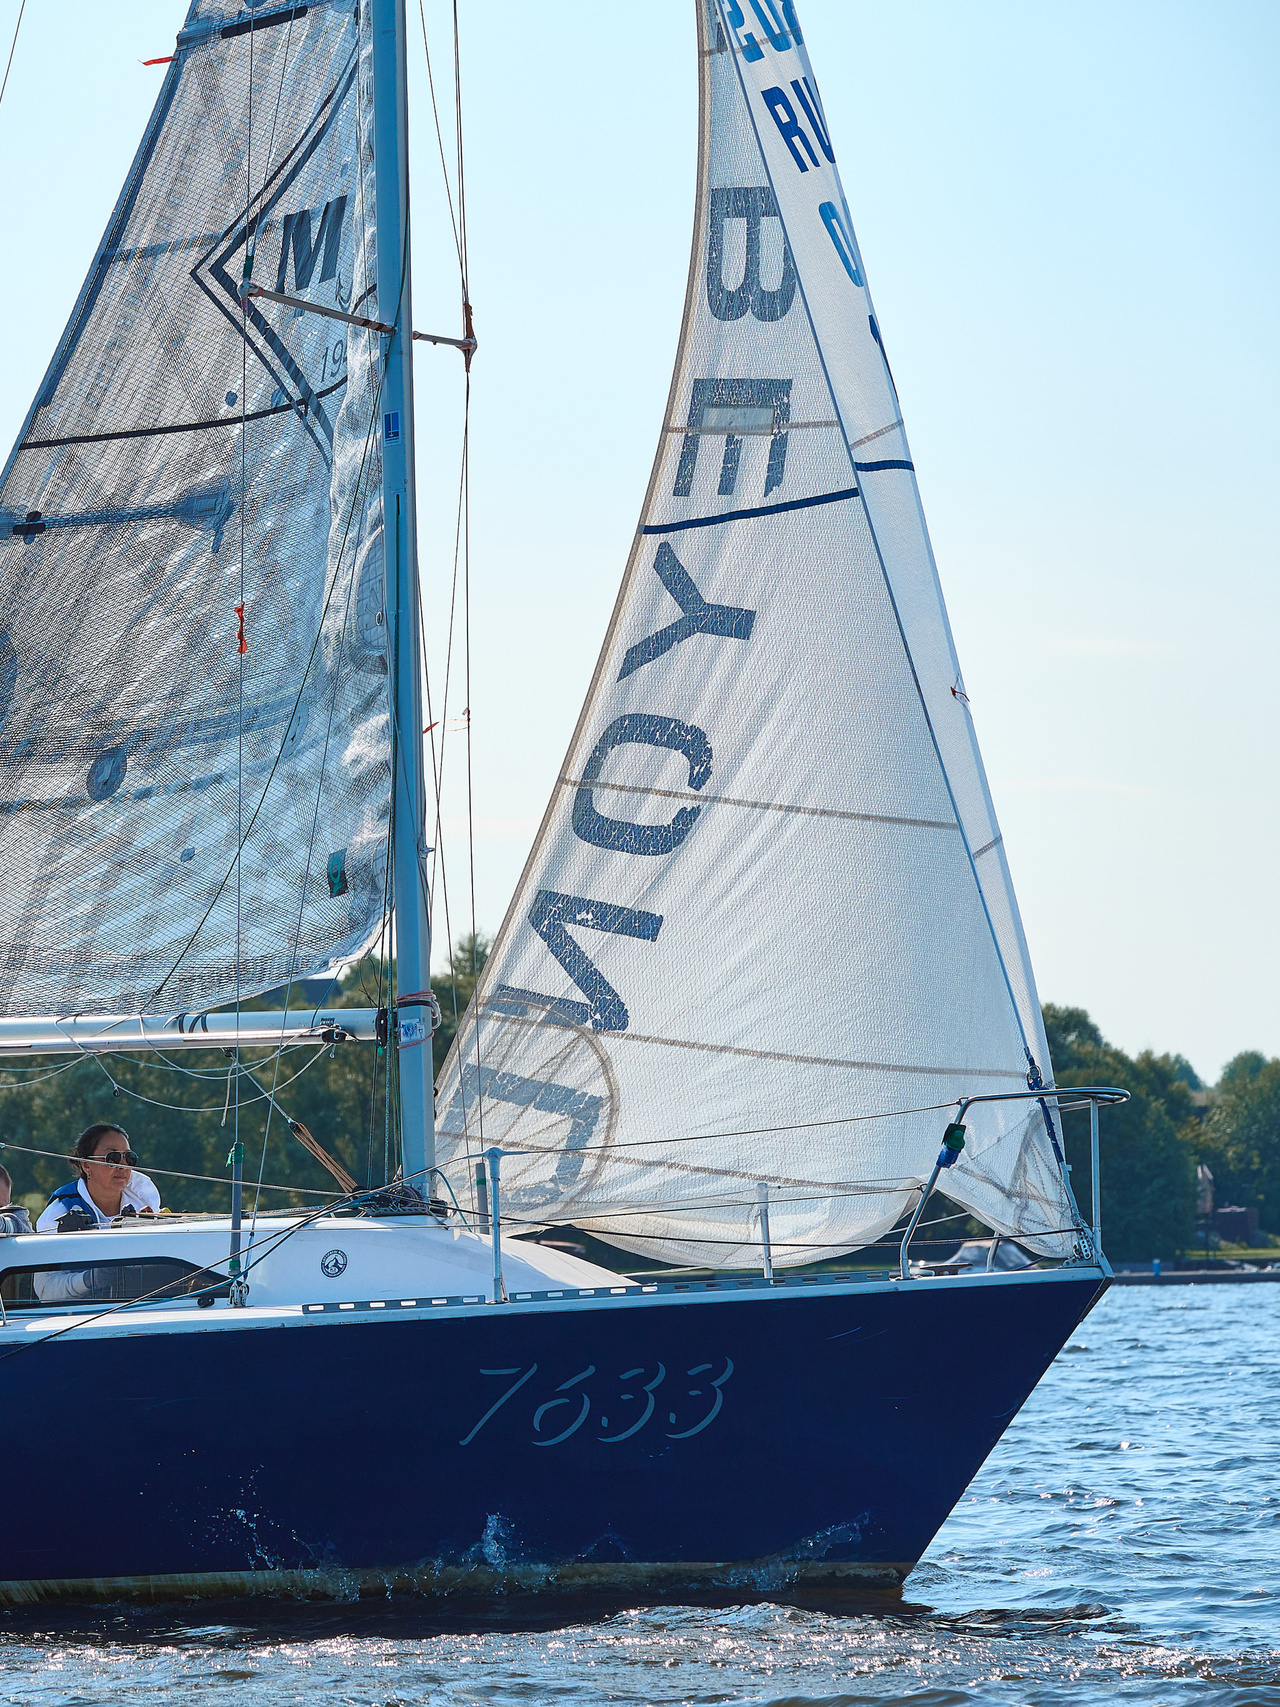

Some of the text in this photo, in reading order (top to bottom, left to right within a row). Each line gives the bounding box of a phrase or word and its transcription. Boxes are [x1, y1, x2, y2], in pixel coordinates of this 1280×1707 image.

[276, 194, 348, 294] M
[321, 339, 348, 383] 19
[459, 1357, 734, 1446] 7633
